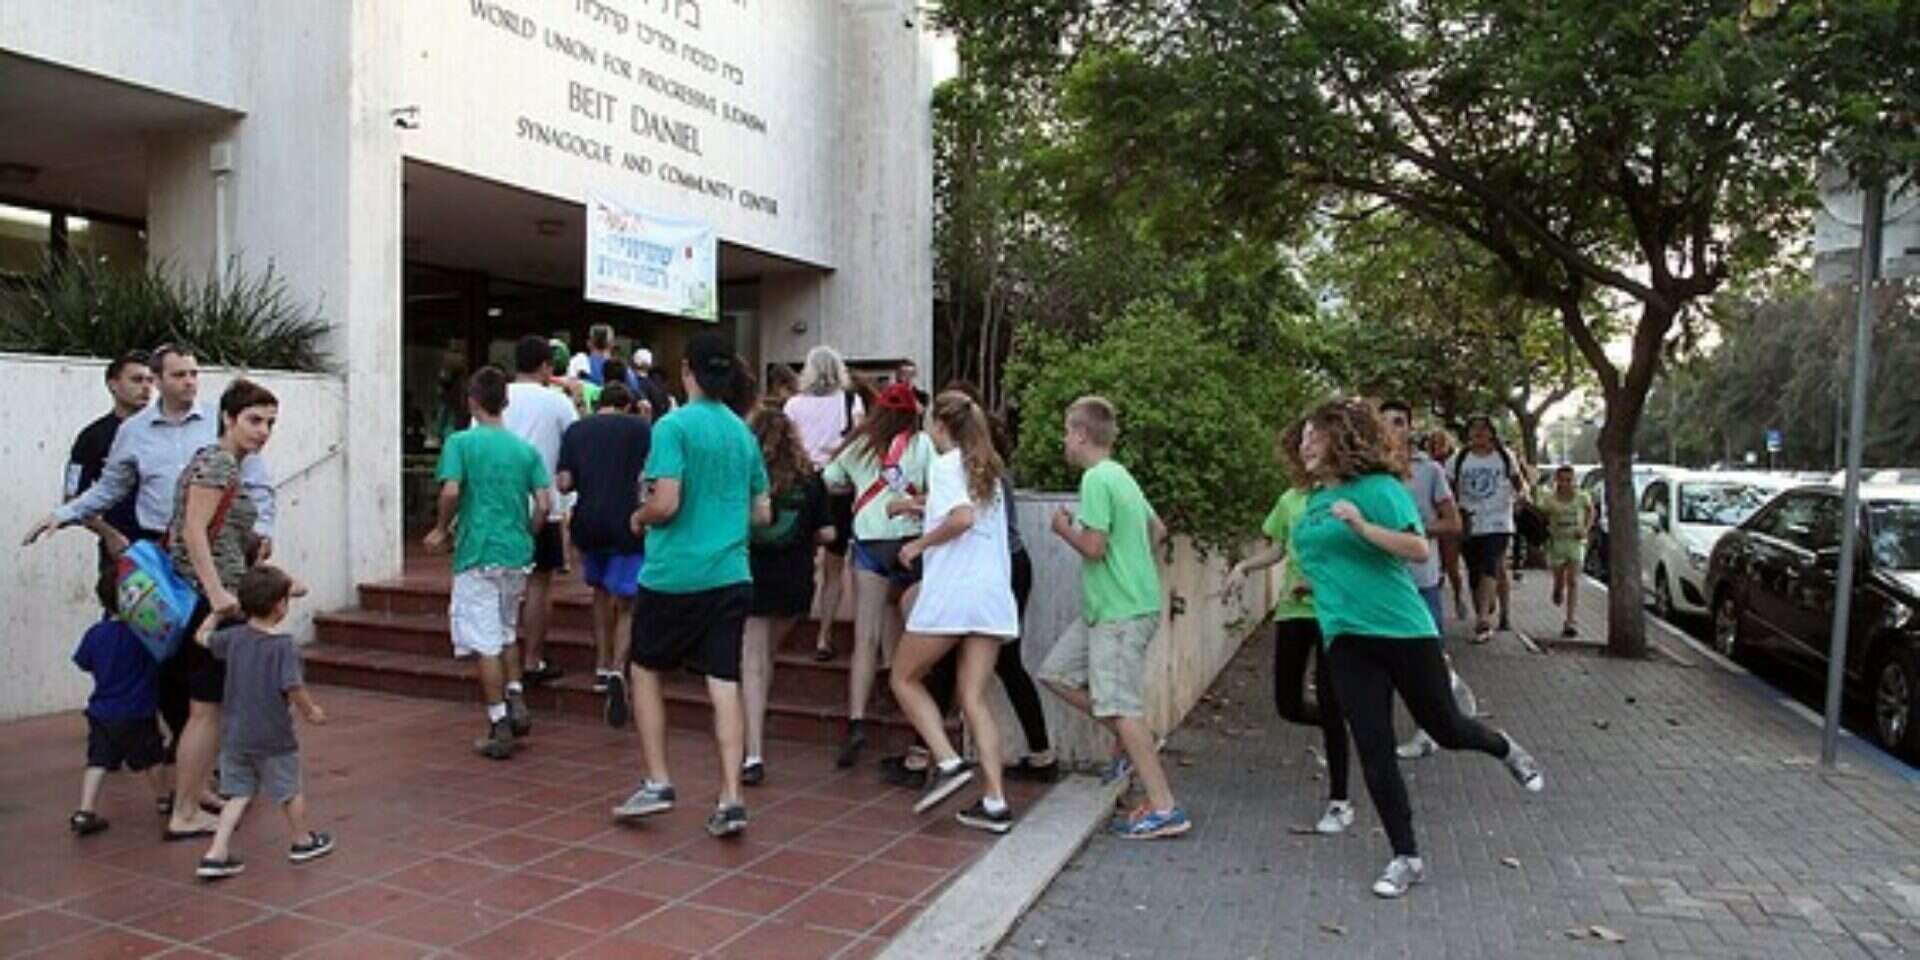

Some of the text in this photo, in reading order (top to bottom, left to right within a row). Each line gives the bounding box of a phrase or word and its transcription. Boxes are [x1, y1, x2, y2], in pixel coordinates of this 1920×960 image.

[470, 0, 767, 134] WORLD UNION FOR PROGRESSIVE JUDAISM
[516, 116, 777, 216] SYNAGOGUE AND COMMUNITY CENTER
[568, 80, 702, 157] BEIT DANIEL
